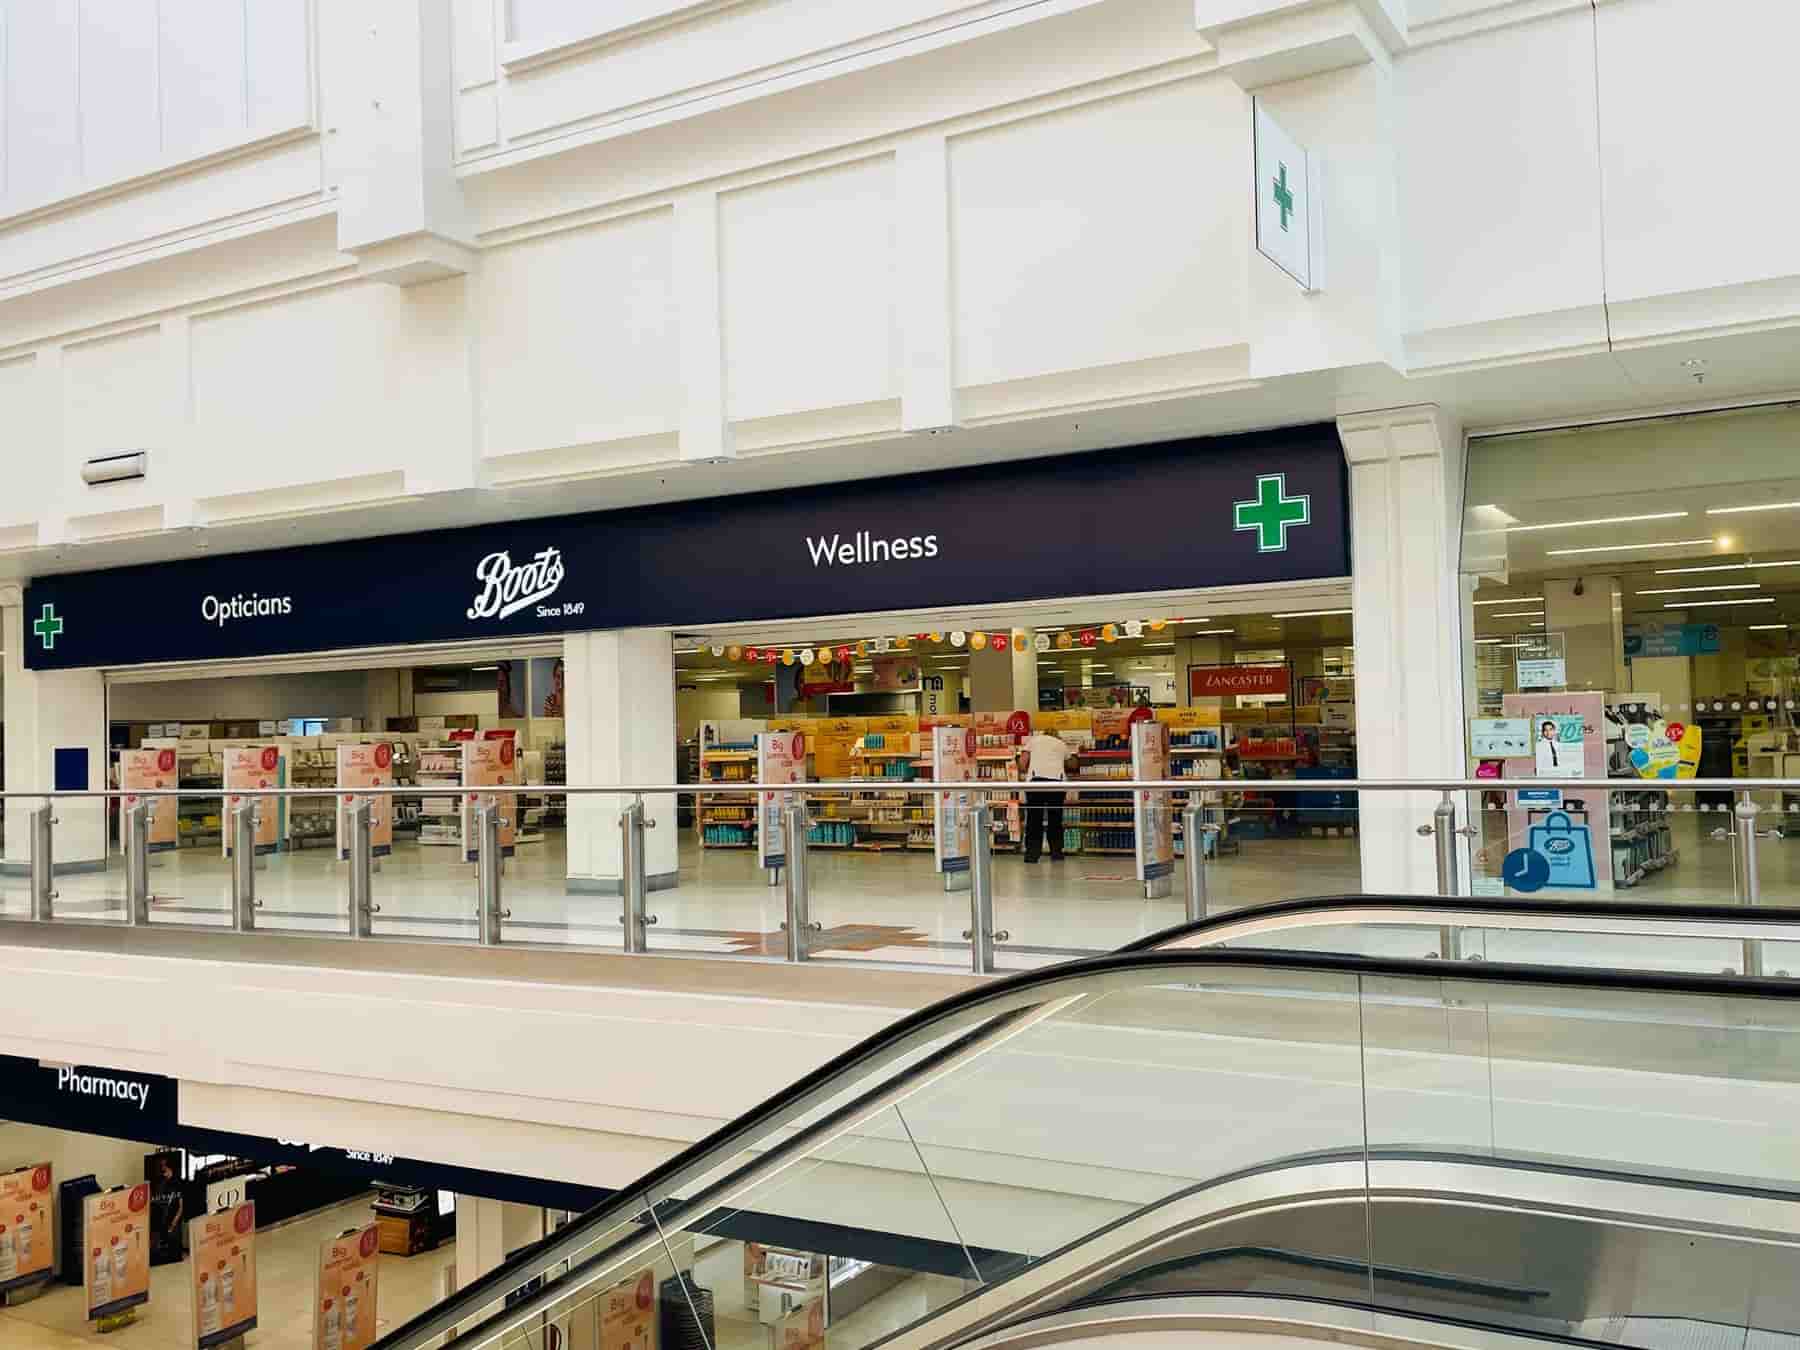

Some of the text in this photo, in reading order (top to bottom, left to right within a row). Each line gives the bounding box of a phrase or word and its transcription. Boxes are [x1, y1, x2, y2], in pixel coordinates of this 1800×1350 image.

[806, 530, 938, 567] Wellness
[466, 546, 565, 620] Boots
[201, 593, 293, 627] Opticians
[536, 602, 585, 618] Since 1849
[1205, 674, 1274, 688] LANCASTER
[58, 1065, 150, 1111] Pharmacy
